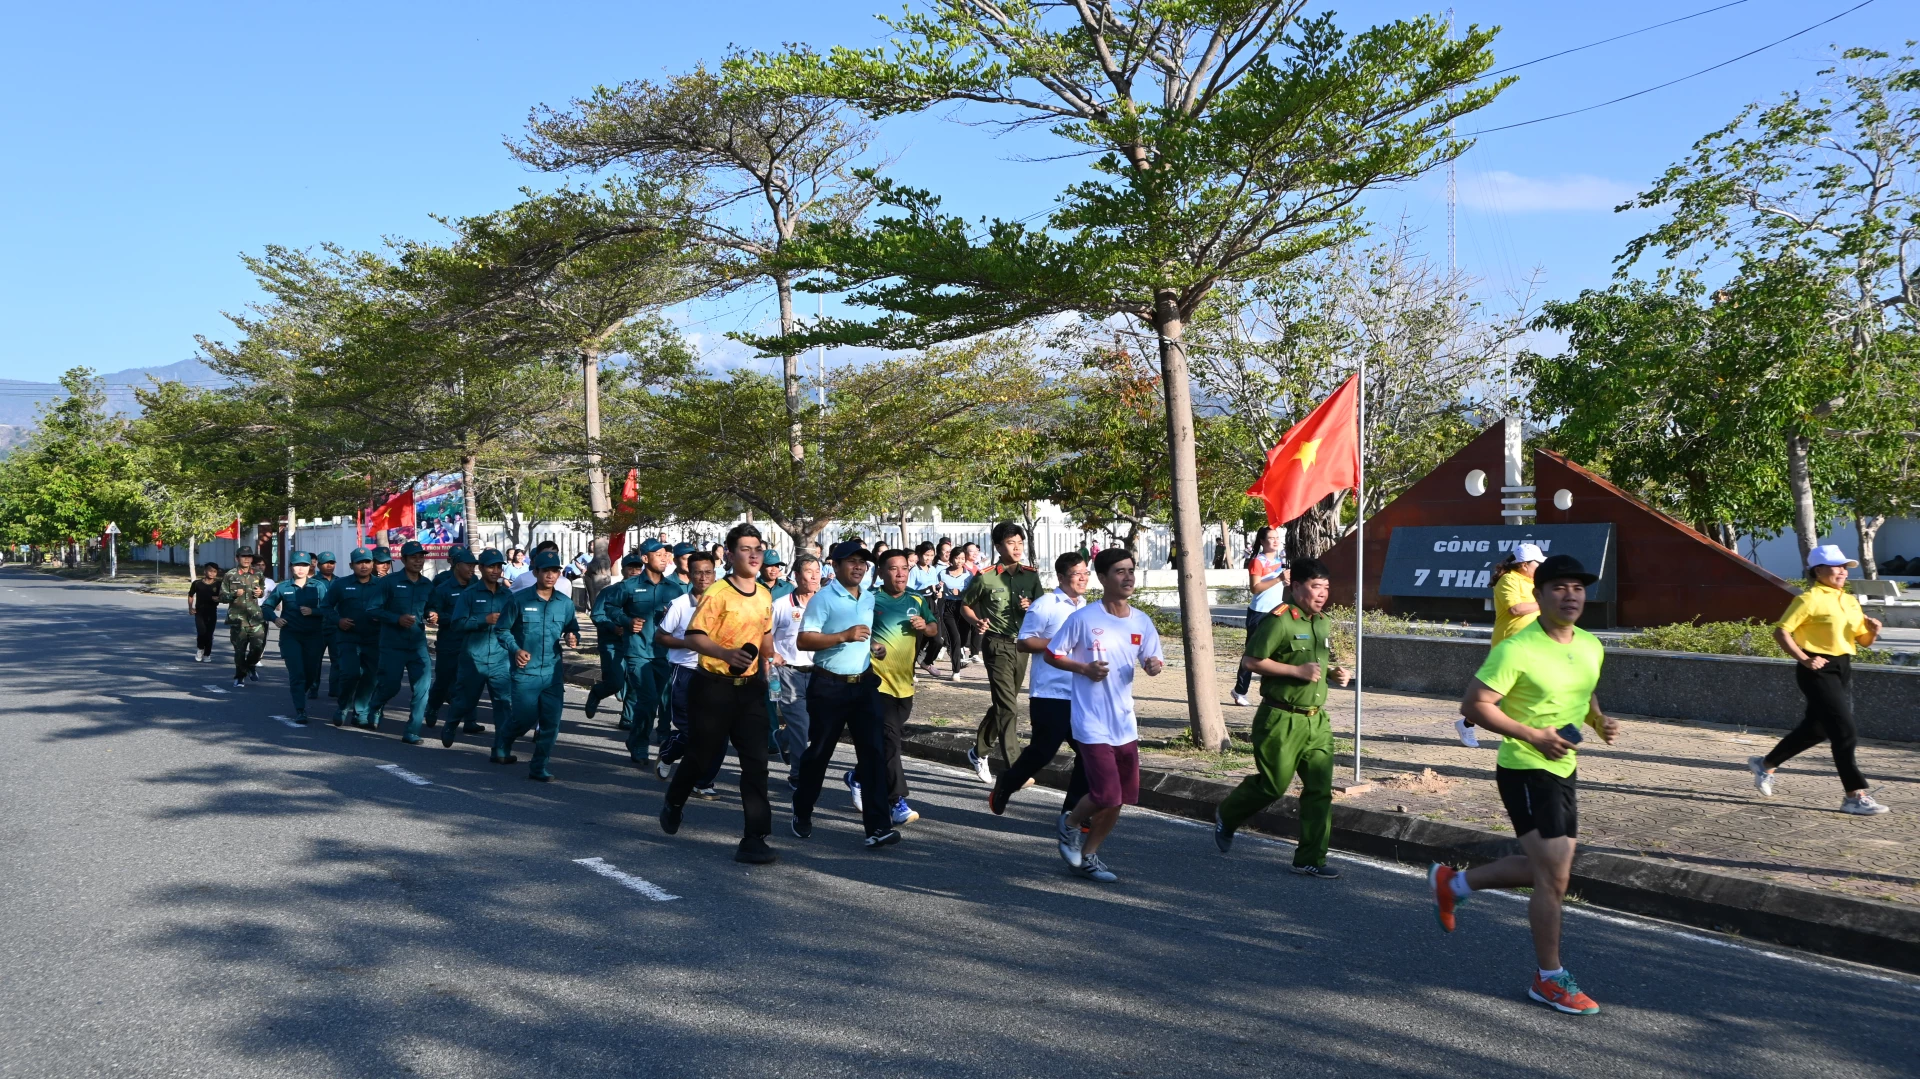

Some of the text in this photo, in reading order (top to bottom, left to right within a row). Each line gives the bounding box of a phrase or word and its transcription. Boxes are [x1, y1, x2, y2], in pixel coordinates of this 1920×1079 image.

[1433, 535, 1490, 552] CÔNG
[1414, 562, 1491, 588] 7 THÁ
